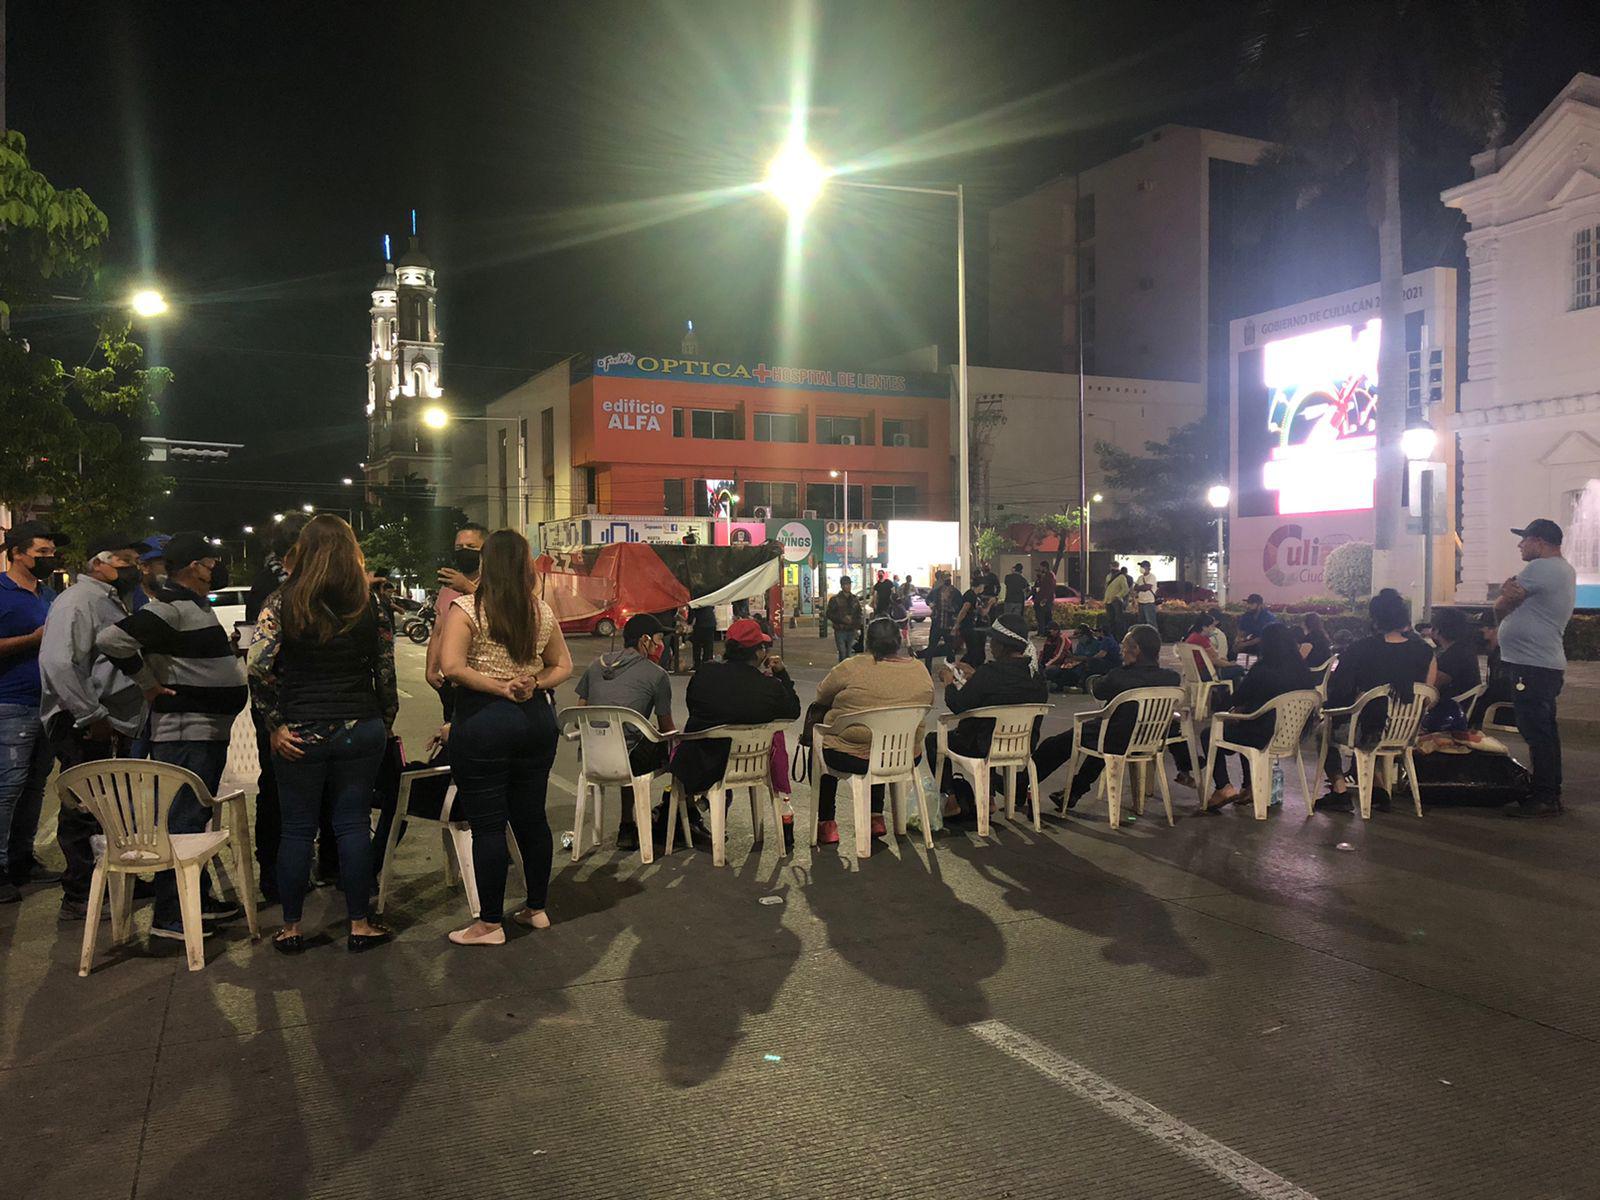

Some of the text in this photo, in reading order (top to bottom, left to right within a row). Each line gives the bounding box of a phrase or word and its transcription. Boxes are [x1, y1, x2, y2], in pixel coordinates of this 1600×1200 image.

[1261, 314, 1308, 335] GOBIERNO
[1309, 309, 1321, 323] DE
[1322, 297, 1374, 319] CULIACÁN
[637, 356, 752, 379] OPTICA
[771, 366, 836, 387] HOSPITAL
[837, 371, 856, 388] DE
[856, 373, 906, 392] LENTES
[603, 399, 666, 414] edificio
[608, 413, 661, 432] ALFA
[778, 537, 811, 547] WINGS
